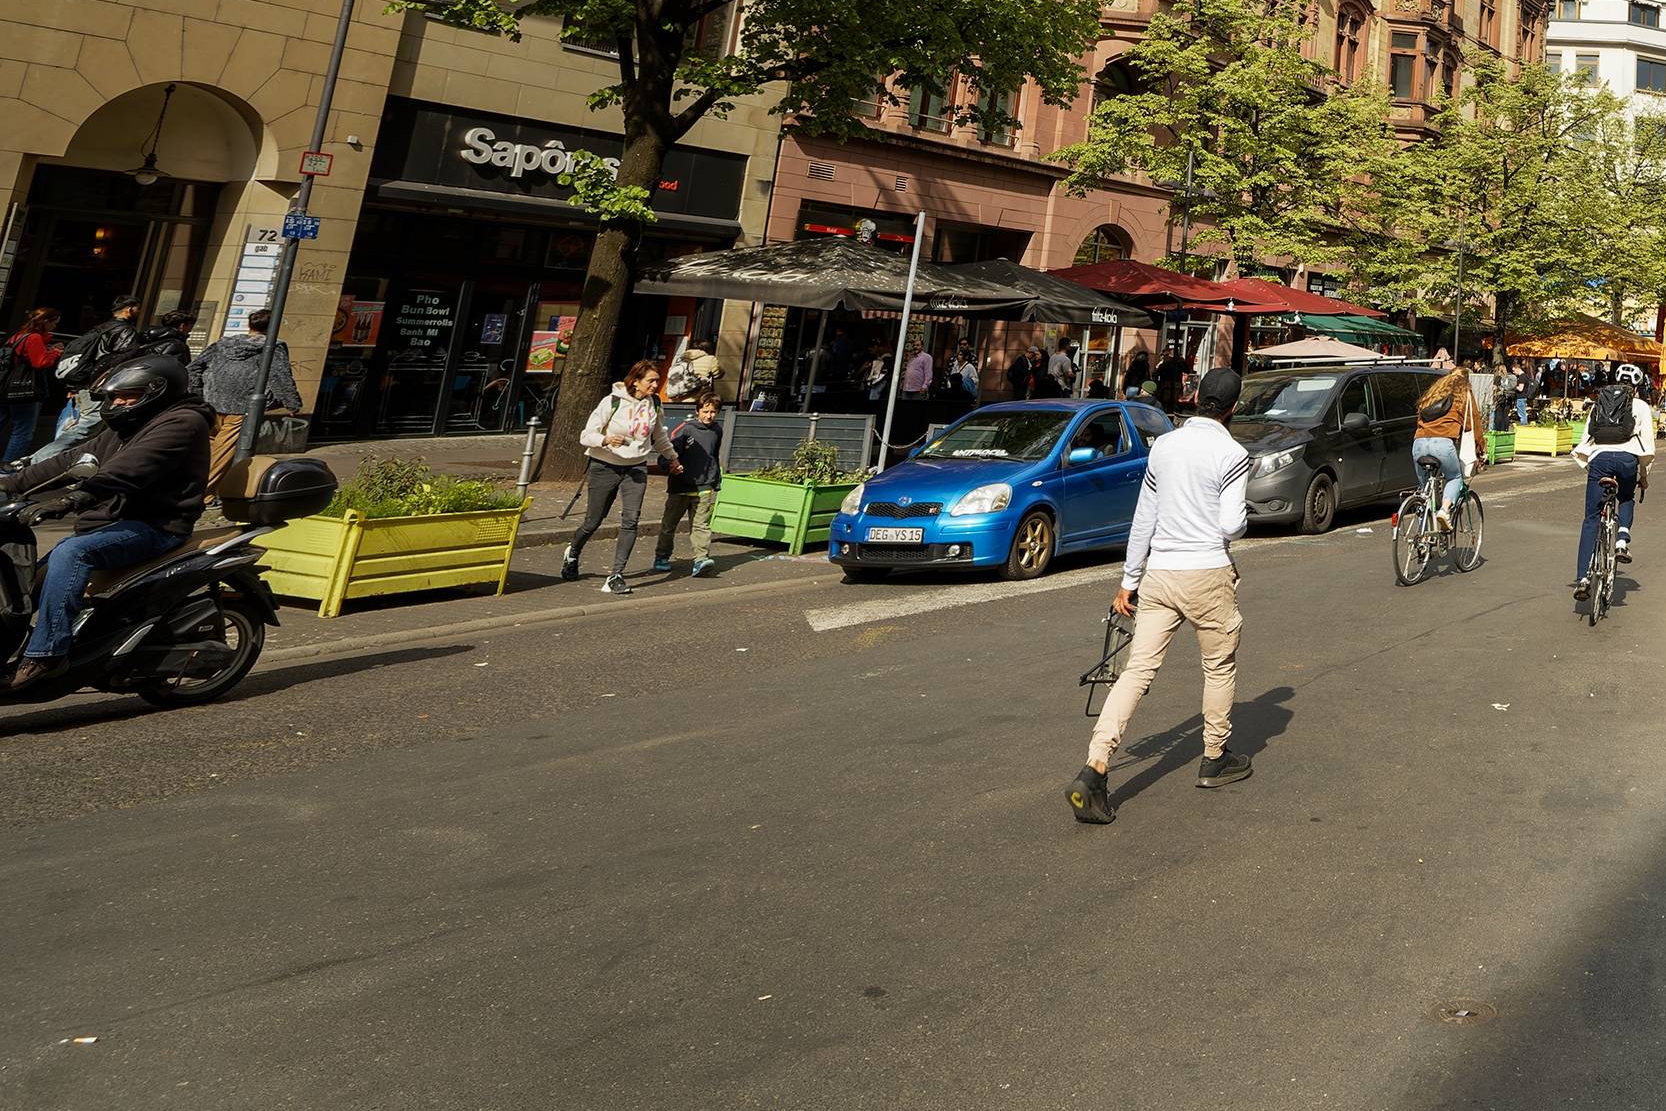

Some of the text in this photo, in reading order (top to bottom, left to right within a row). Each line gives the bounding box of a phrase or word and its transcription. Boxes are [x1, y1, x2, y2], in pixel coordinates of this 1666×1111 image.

[258, 230, 278, 242] 72
[416, 295, 440, 305] Pho
[401, 305, 450, 316] Bun Bowl
[396, 316, 453, 327] Summerrolls
[410, 337, 431, 346] Bao
[870, 529, 921, 540] DEG YS 15
